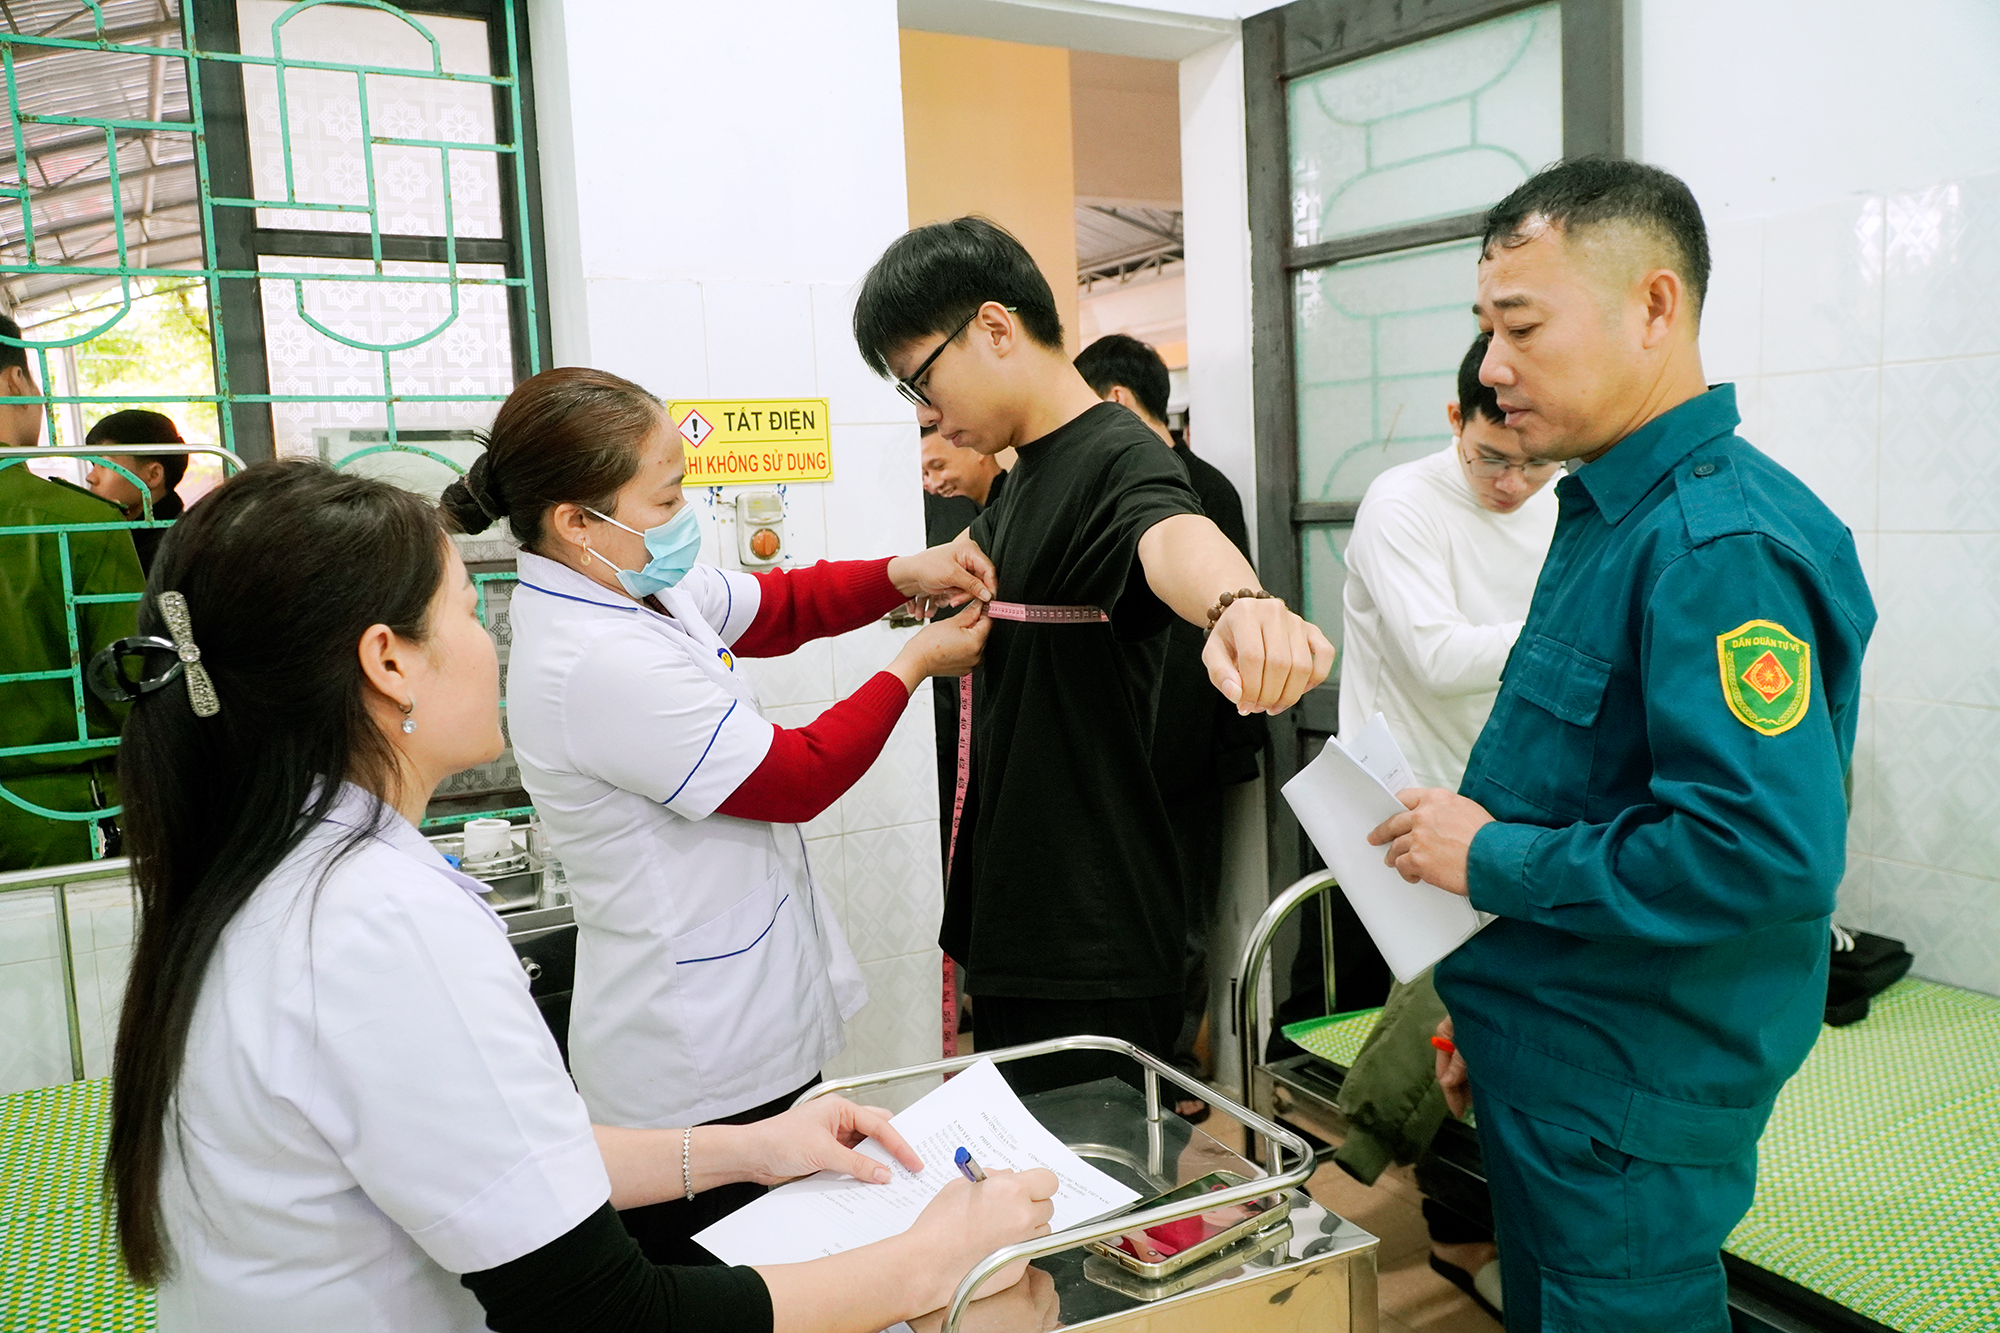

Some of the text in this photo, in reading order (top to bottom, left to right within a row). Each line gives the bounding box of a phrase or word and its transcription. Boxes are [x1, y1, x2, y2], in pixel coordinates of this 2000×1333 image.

[769, 409, 815, 435] ĐIỆN
[707, 451, 758, 473] KHÔNG
[763, 449, 783, 471] SỬ
[787, 452, 826, 475] DỤNG
[1732, 637, 1751, 648] DÂN
[1753, 636, 1776, 647] QUÂN
[961, 678, 967, 690] 38
[961, 697, 967, 710] 39
[961, 717, 967, 729] 40
[960, 737, 965, 748] 41
[959, 757, 965, 769] 42
[959, 776, 965, 789] 43
